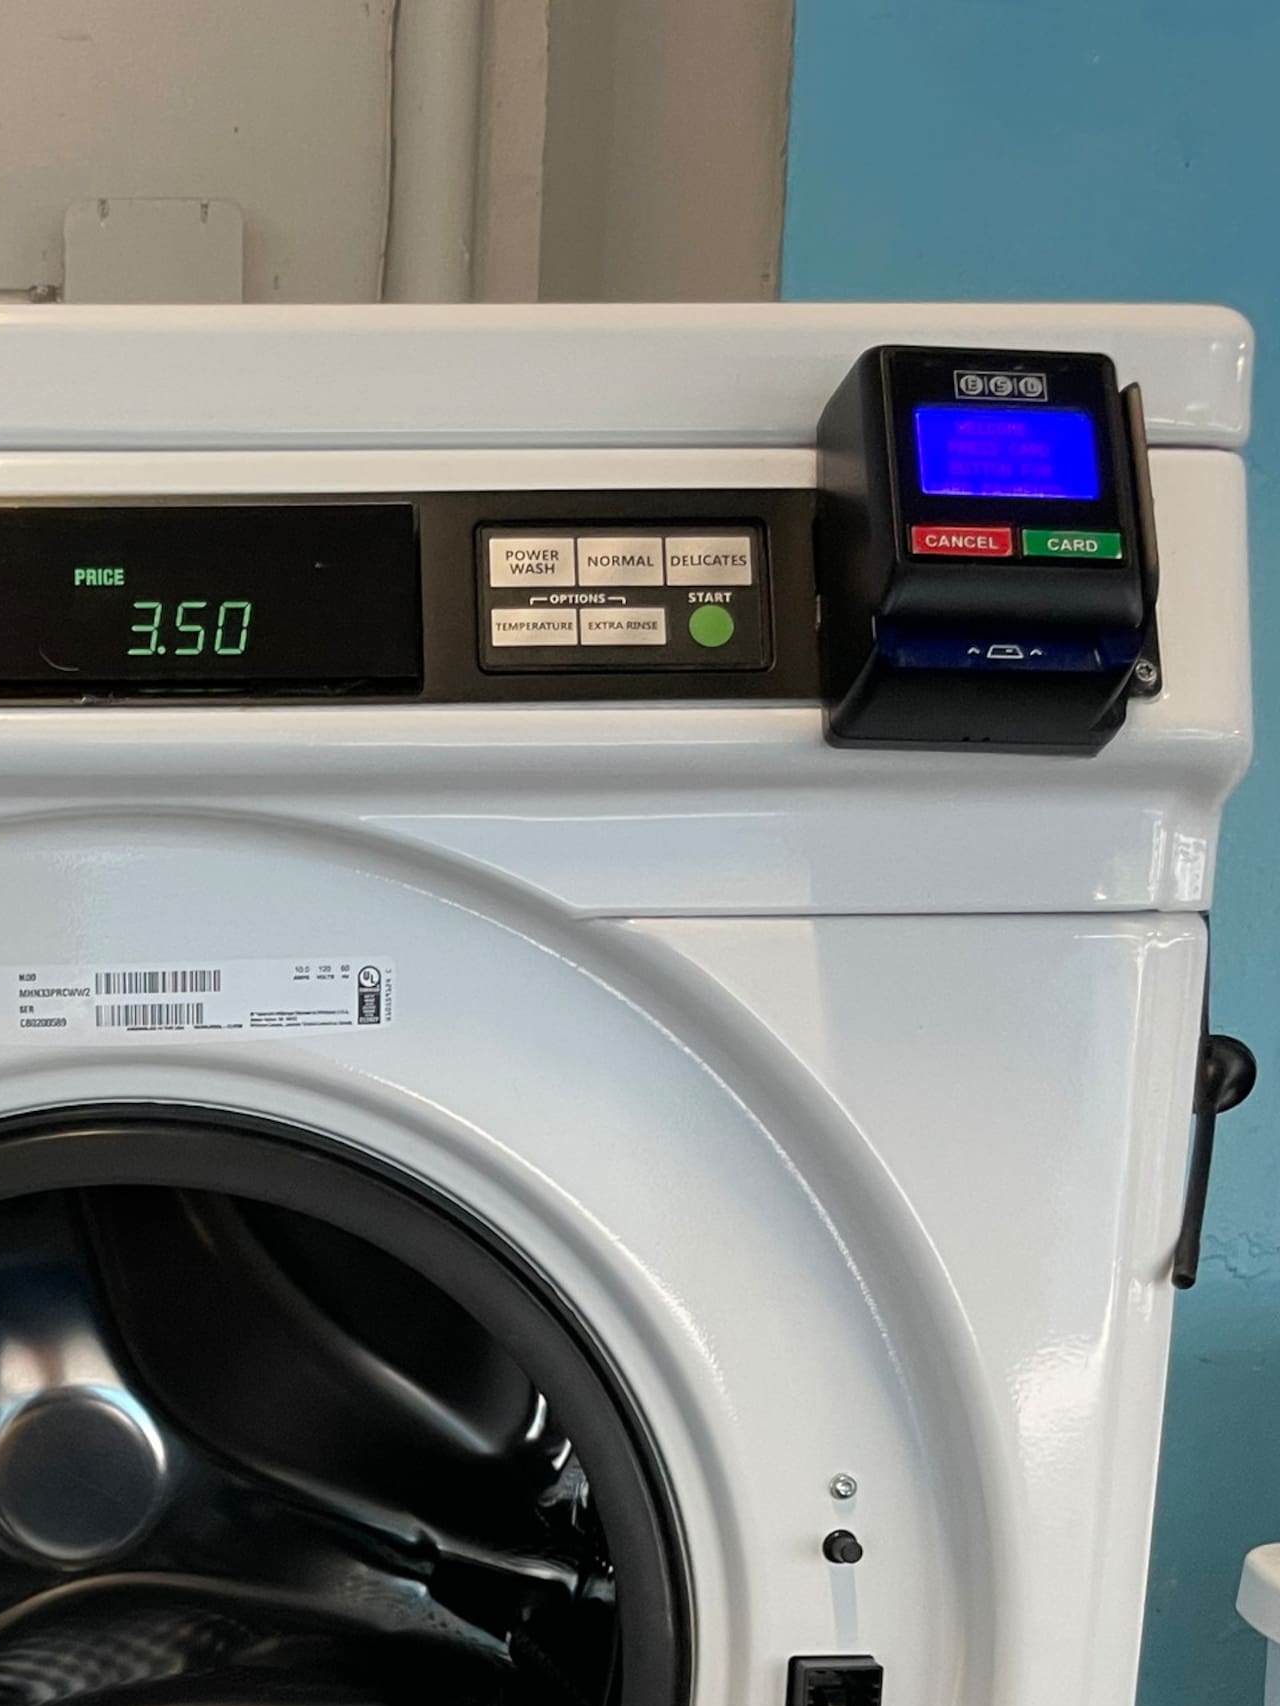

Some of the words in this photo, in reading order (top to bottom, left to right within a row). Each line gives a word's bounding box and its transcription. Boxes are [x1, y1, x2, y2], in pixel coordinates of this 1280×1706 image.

[925, 534, 999, 551] CANCEL
[1047, 537, 1098, 553] CARD
[505, 549, 560, 562] POWER
[587, 555, 654, 568] NORMAL
[670, 554, 747, 567] DELICATES
[510, 563, 555, 575] WASH
[74, 567, 125, 587] PRICE
[550, 594, 606, 605] OPTIONS
[688, 592, 732, 604] START
[127, 601, 252, 656] 3.50
[496, 621, 573, 632] TEMPERATURE
[588, 621, 623, 631] EXTRA
[626, 621, 658, 631] RINSE
